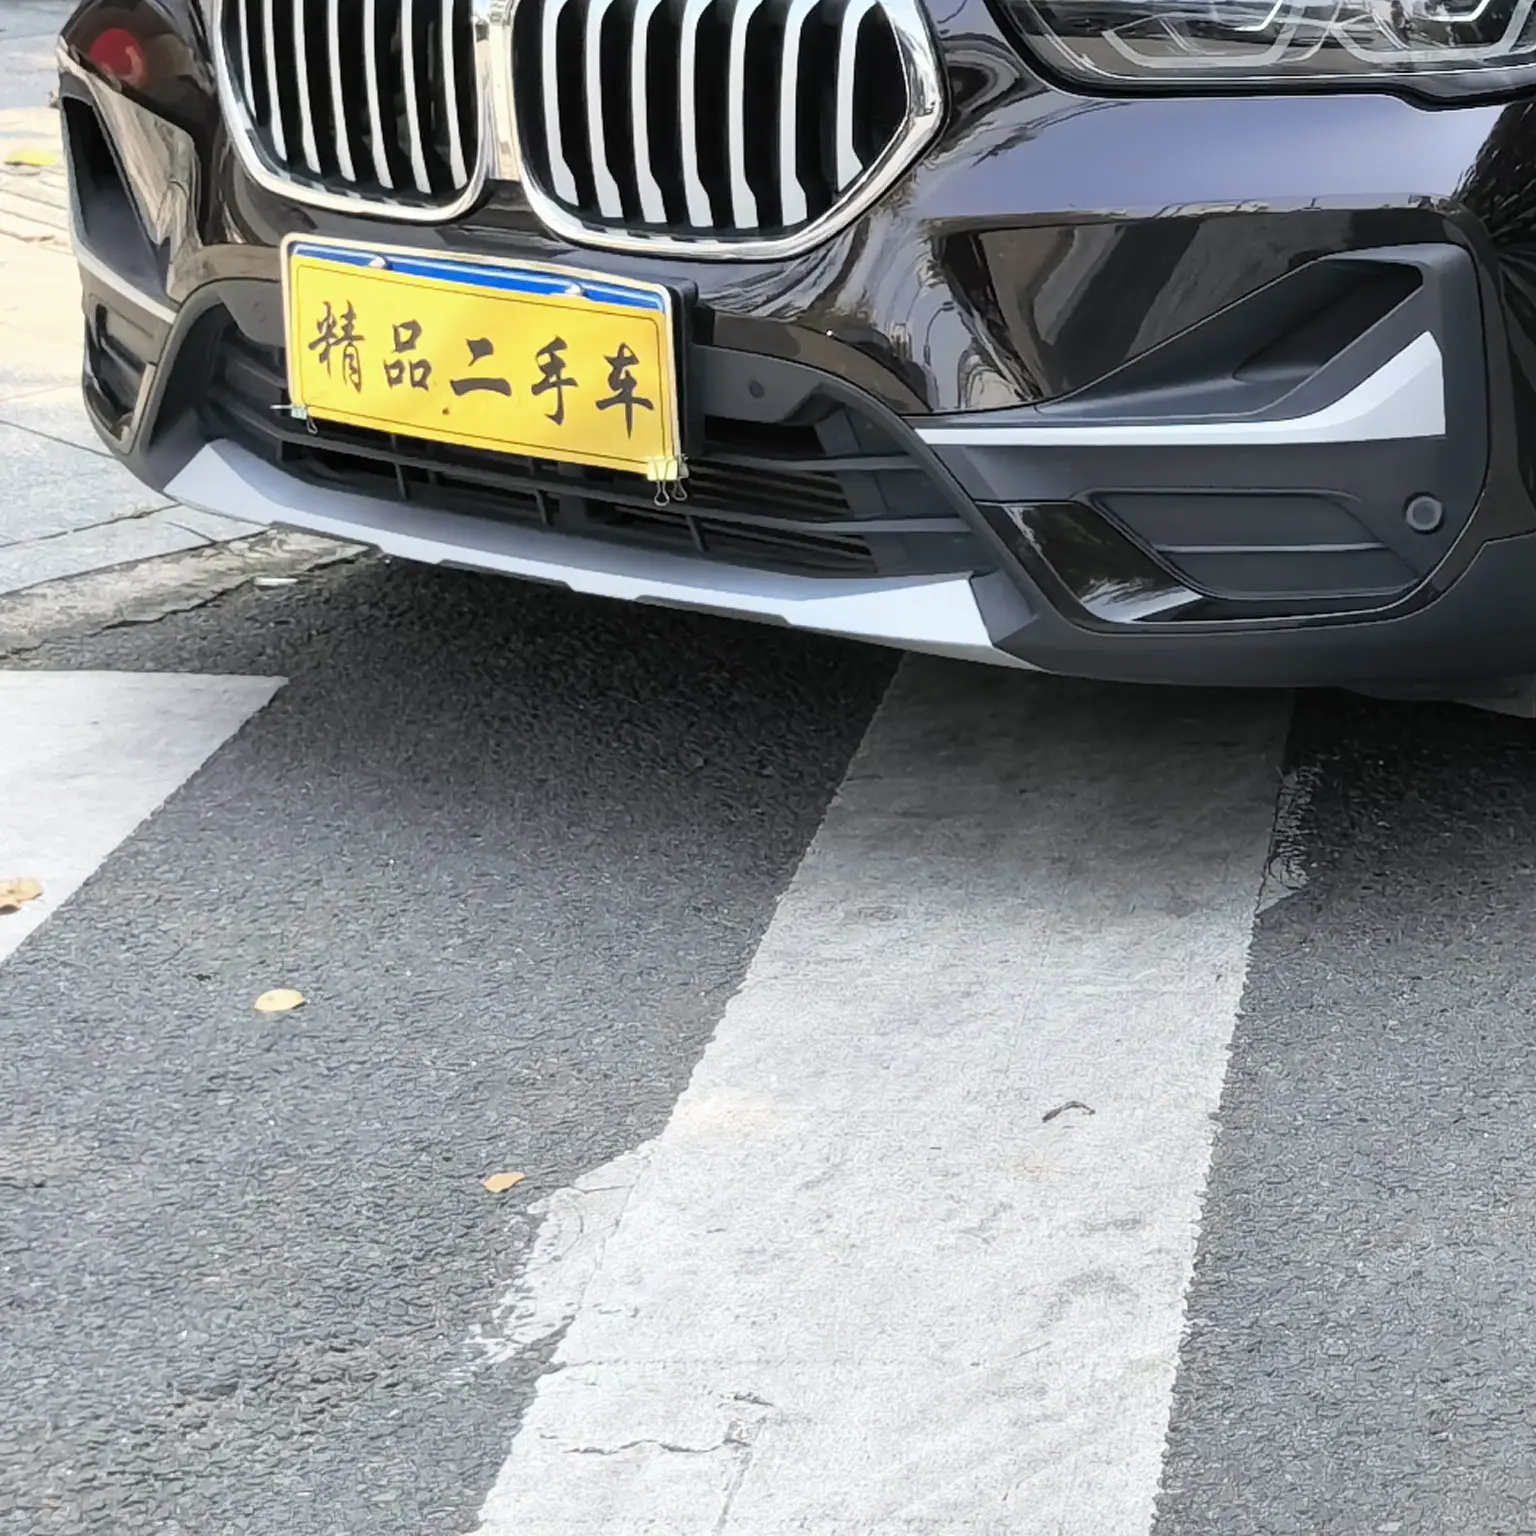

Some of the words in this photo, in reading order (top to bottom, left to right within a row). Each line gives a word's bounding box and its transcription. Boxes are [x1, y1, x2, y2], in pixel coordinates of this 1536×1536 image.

[308, 299, 655, 439] 精品二手车
